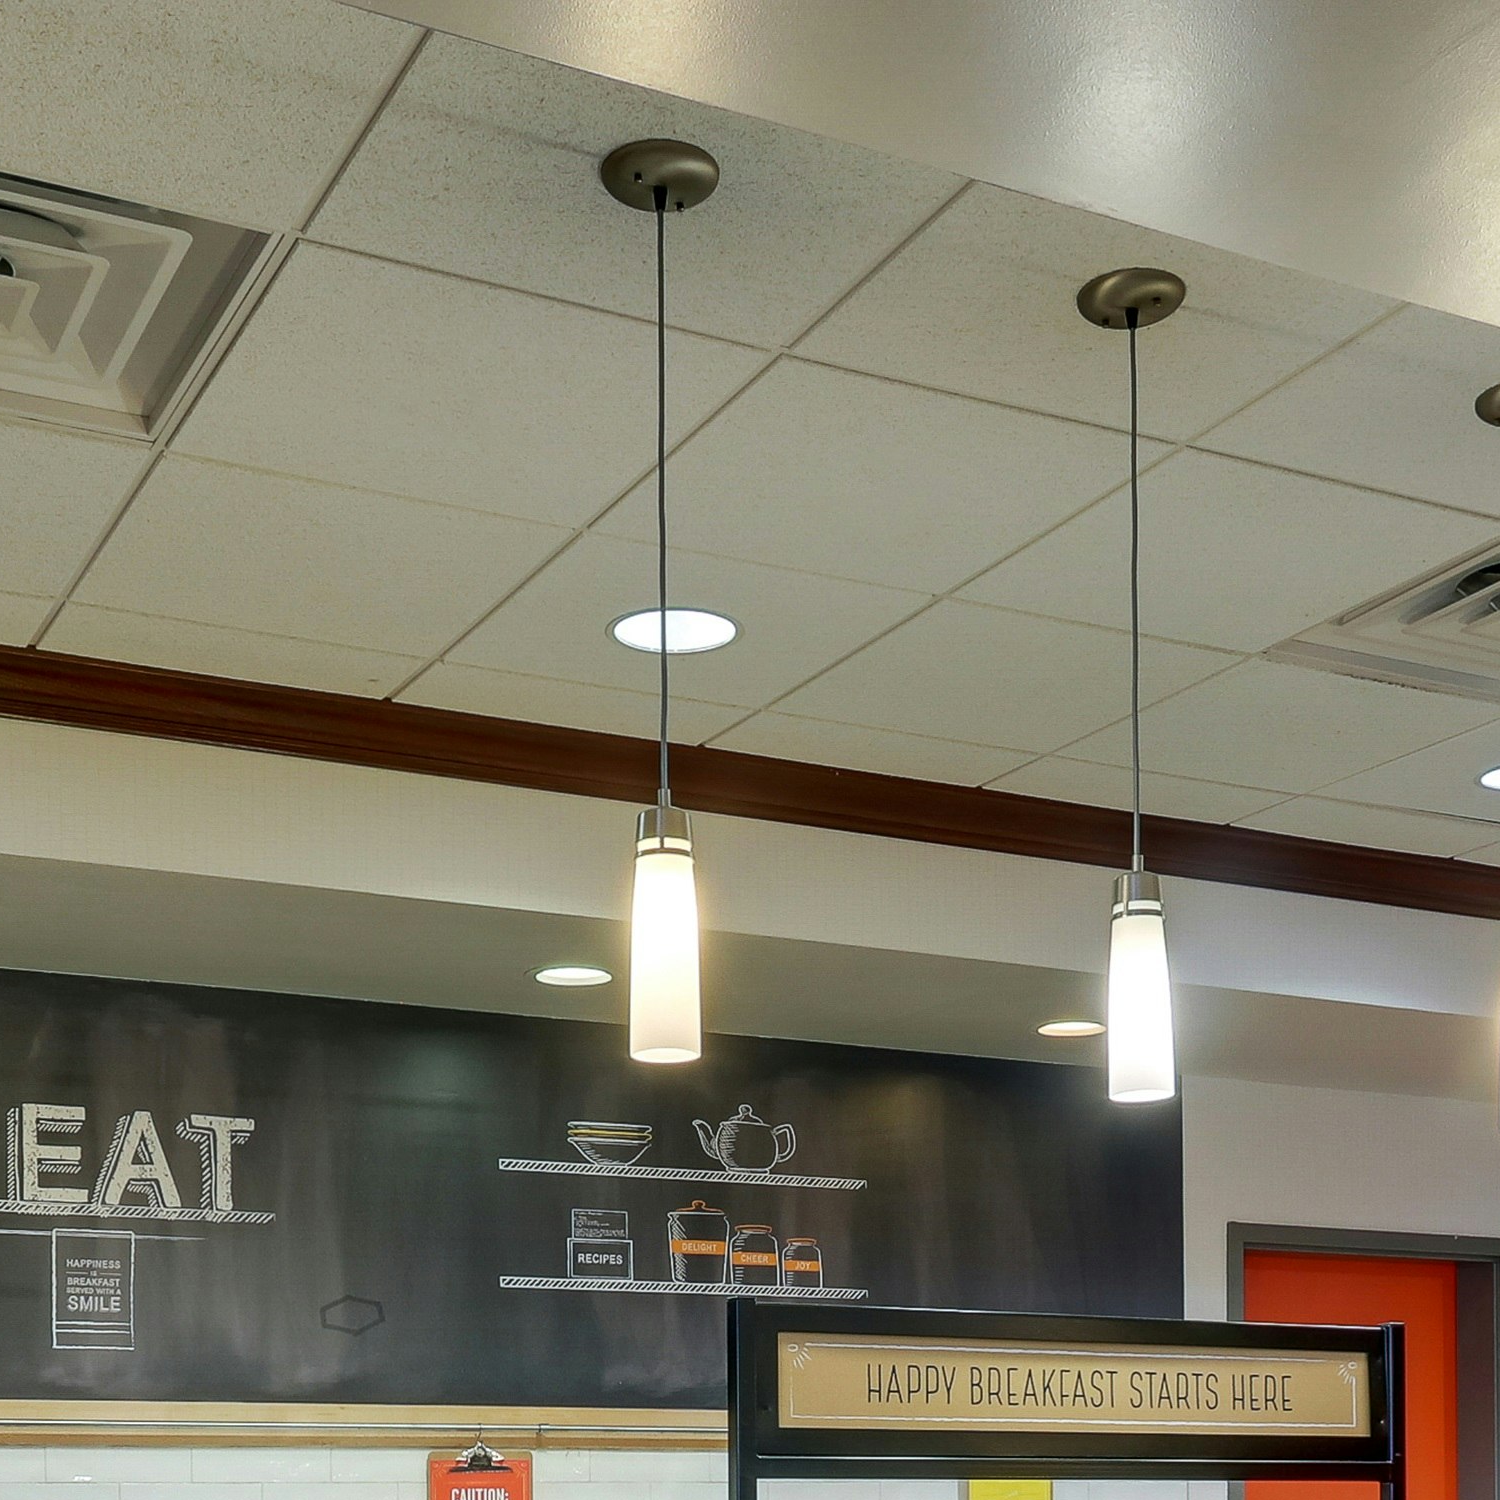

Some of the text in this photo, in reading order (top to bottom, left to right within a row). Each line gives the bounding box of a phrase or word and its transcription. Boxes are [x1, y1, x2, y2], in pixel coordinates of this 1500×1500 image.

[8, 1102, 256, 1213] EAT
[681, 1242, 717, 1252] DELIGHT
[66, 1259, 121, 1269] HAPPINESS
[577, 1253, 623, 1265] RECIPES
[740, 1254, 769, 1264] CHEER
[795, 1261, 812, 1270] JOY
[67, 1277, 121, 1287] BREAKFAST
[67, 1295, 122, 1312] SMILE
[867, 1363, 1293, 1412] HAPPY BREAKFAST STARTS HERE
